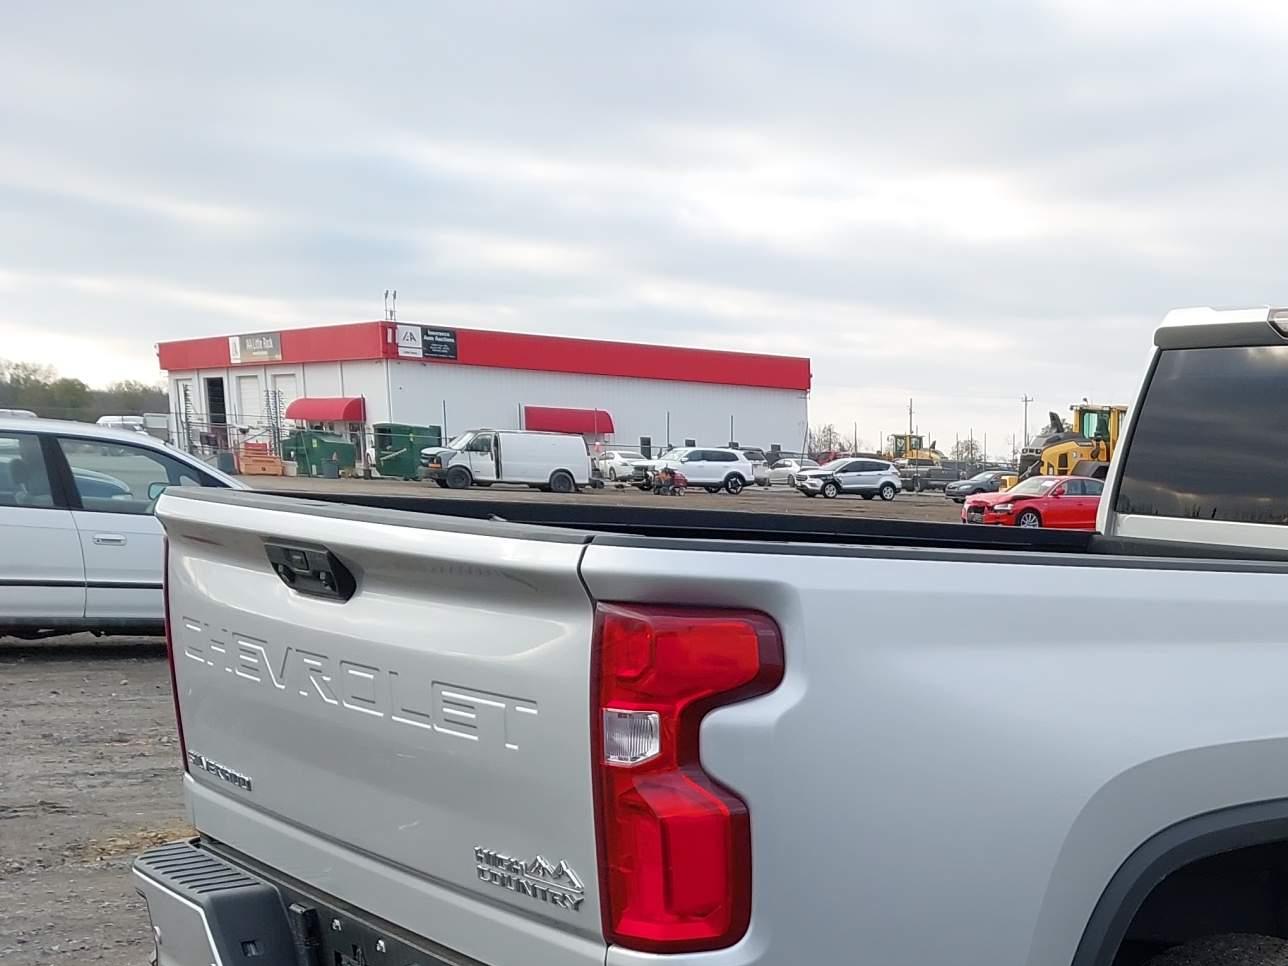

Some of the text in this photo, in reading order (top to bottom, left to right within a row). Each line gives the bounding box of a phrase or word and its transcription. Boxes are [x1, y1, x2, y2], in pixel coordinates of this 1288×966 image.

[181, 615, 539, 751] CHEVROLET
[474, 846, 527, 876] HIGH
[477, 864, 584, 912] COUNTRY
